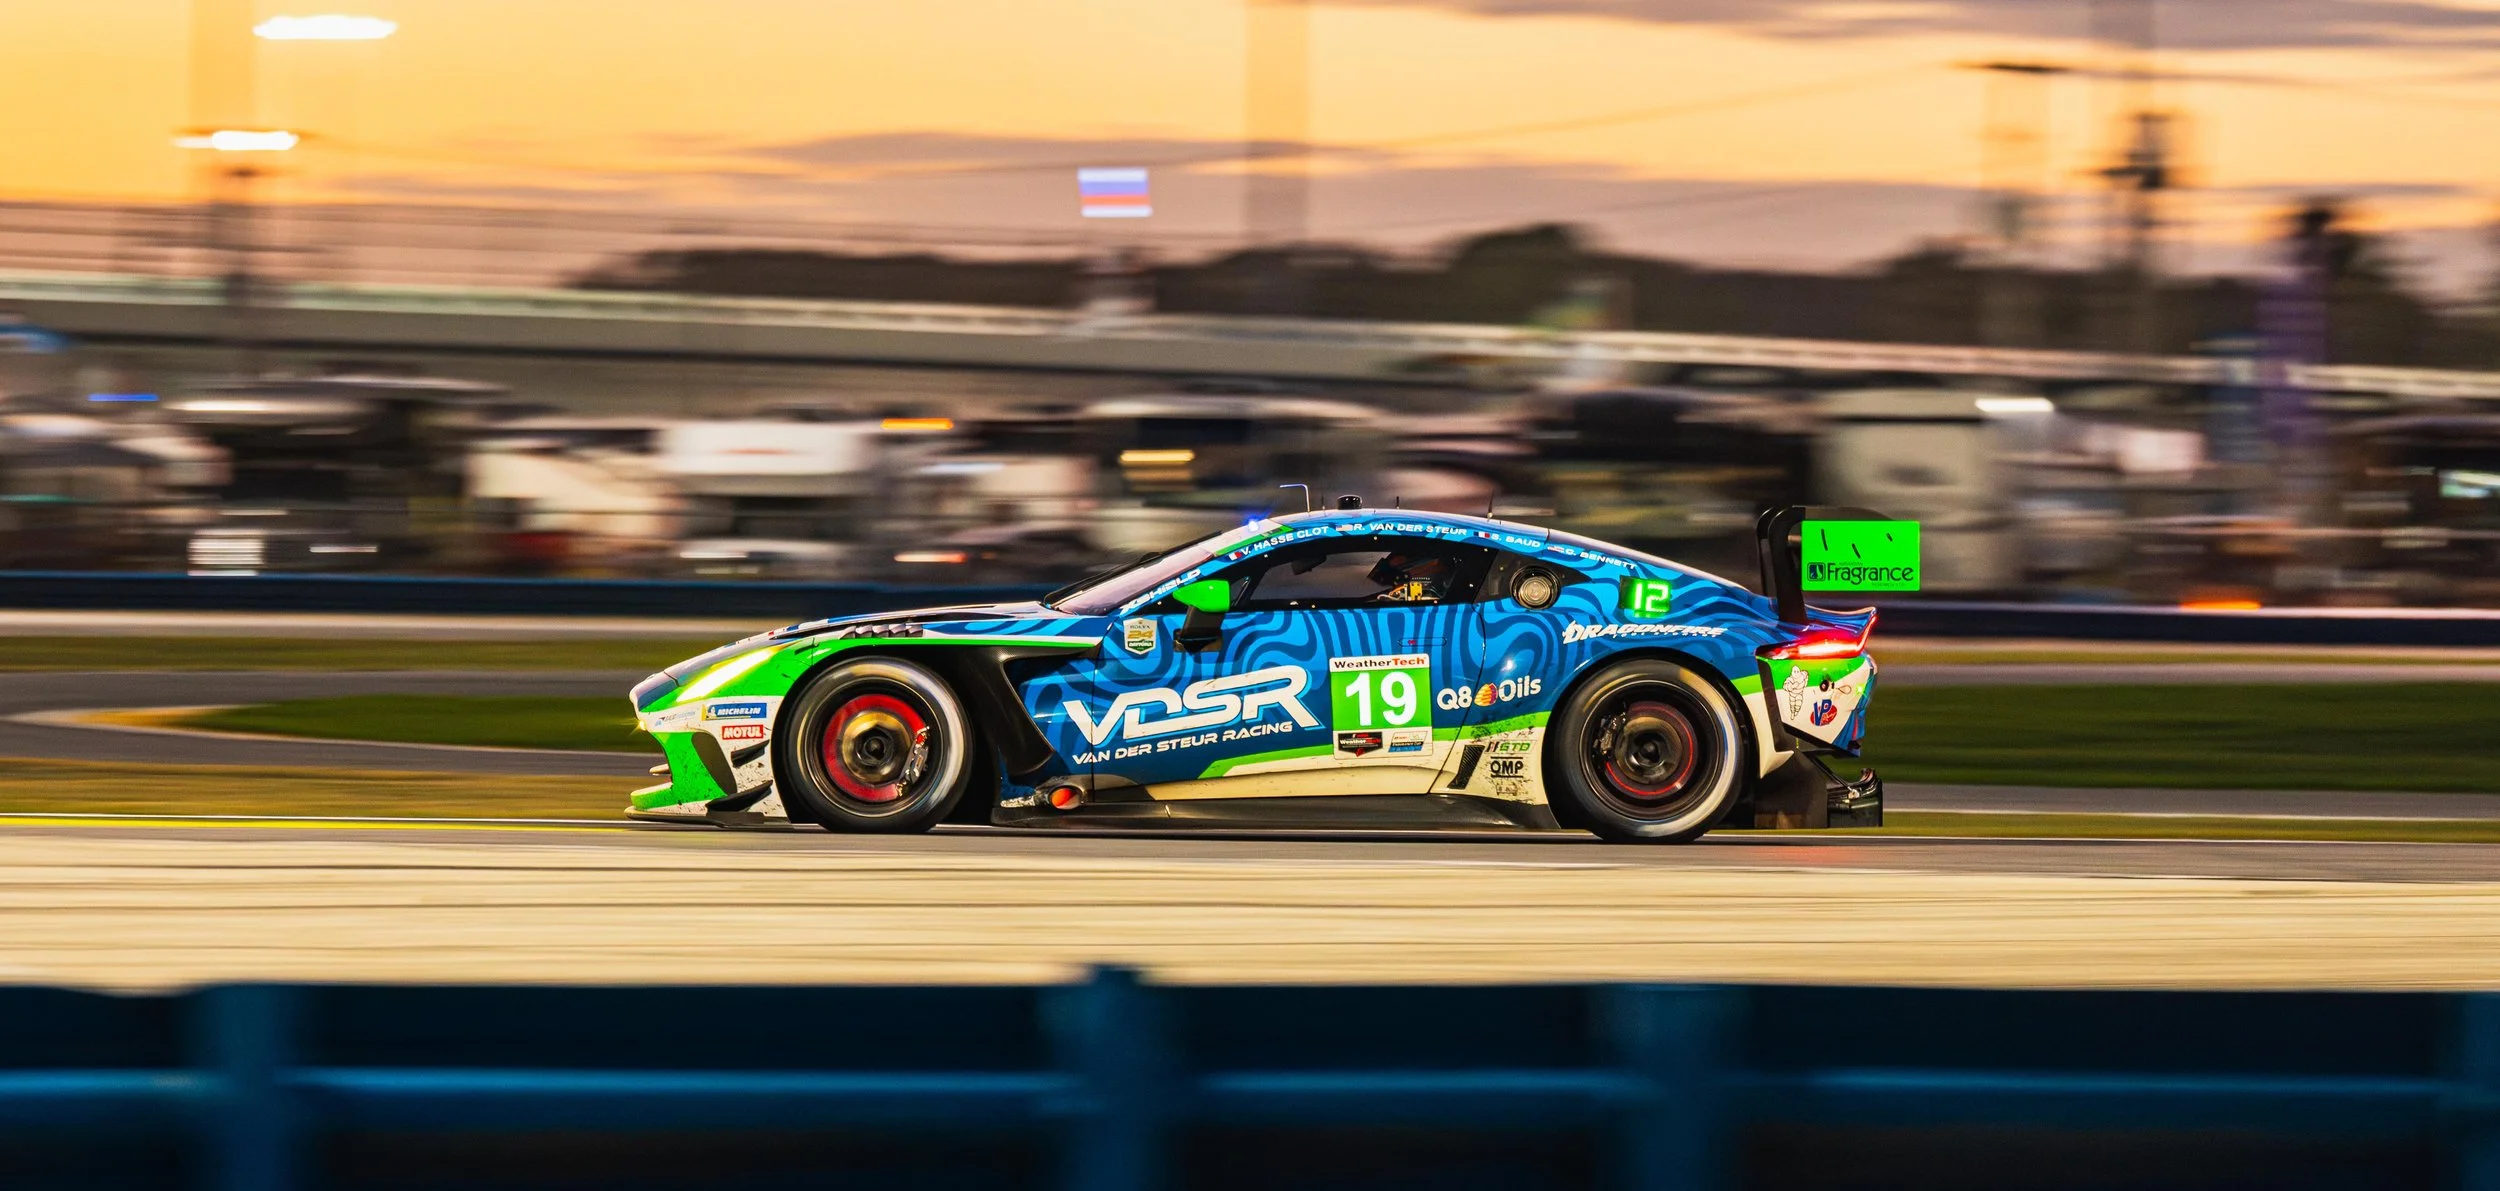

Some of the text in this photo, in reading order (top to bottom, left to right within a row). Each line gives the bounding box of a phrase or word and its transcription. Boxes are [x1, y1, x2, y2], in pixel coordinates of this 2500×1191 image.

[1353, 523, 1468, 536] R. VAN DER STEUR
[1241, 546, 1250, 556] V.
[1254, 533, 1294, 551] HASSE
[1297, 526, 1329, 539] CLOT
[1491, 533, 1541, 548] S. BAUD
[1580, 552, 1638, 570] BENNETT
[1827, 562, 1914, 585] Fragrance
[1634, 582, 1668, 612] 12
[1127, 630, 1153, 639] 24
[1562, 620, 1728, 645] DRAGONFIRE
[1334, 657, 1425, 669] WeatherTech
[1345, 671, 1417, 726] 19
[1437, 675, 1541, 710] Q8 Oils
[717, 707, 761, 715] MICHELIN
[1062, 665, 1319, 746] VDSR
[1813, 699, 1832, 726] VP
[723, 726, 762, 739] MOTUL
[1072, 721, 1293, 765] VAN DER STEUR RACING
[1500, 742, 1531, 751] GTD
[1490, 760, 1523, 774] OMP
